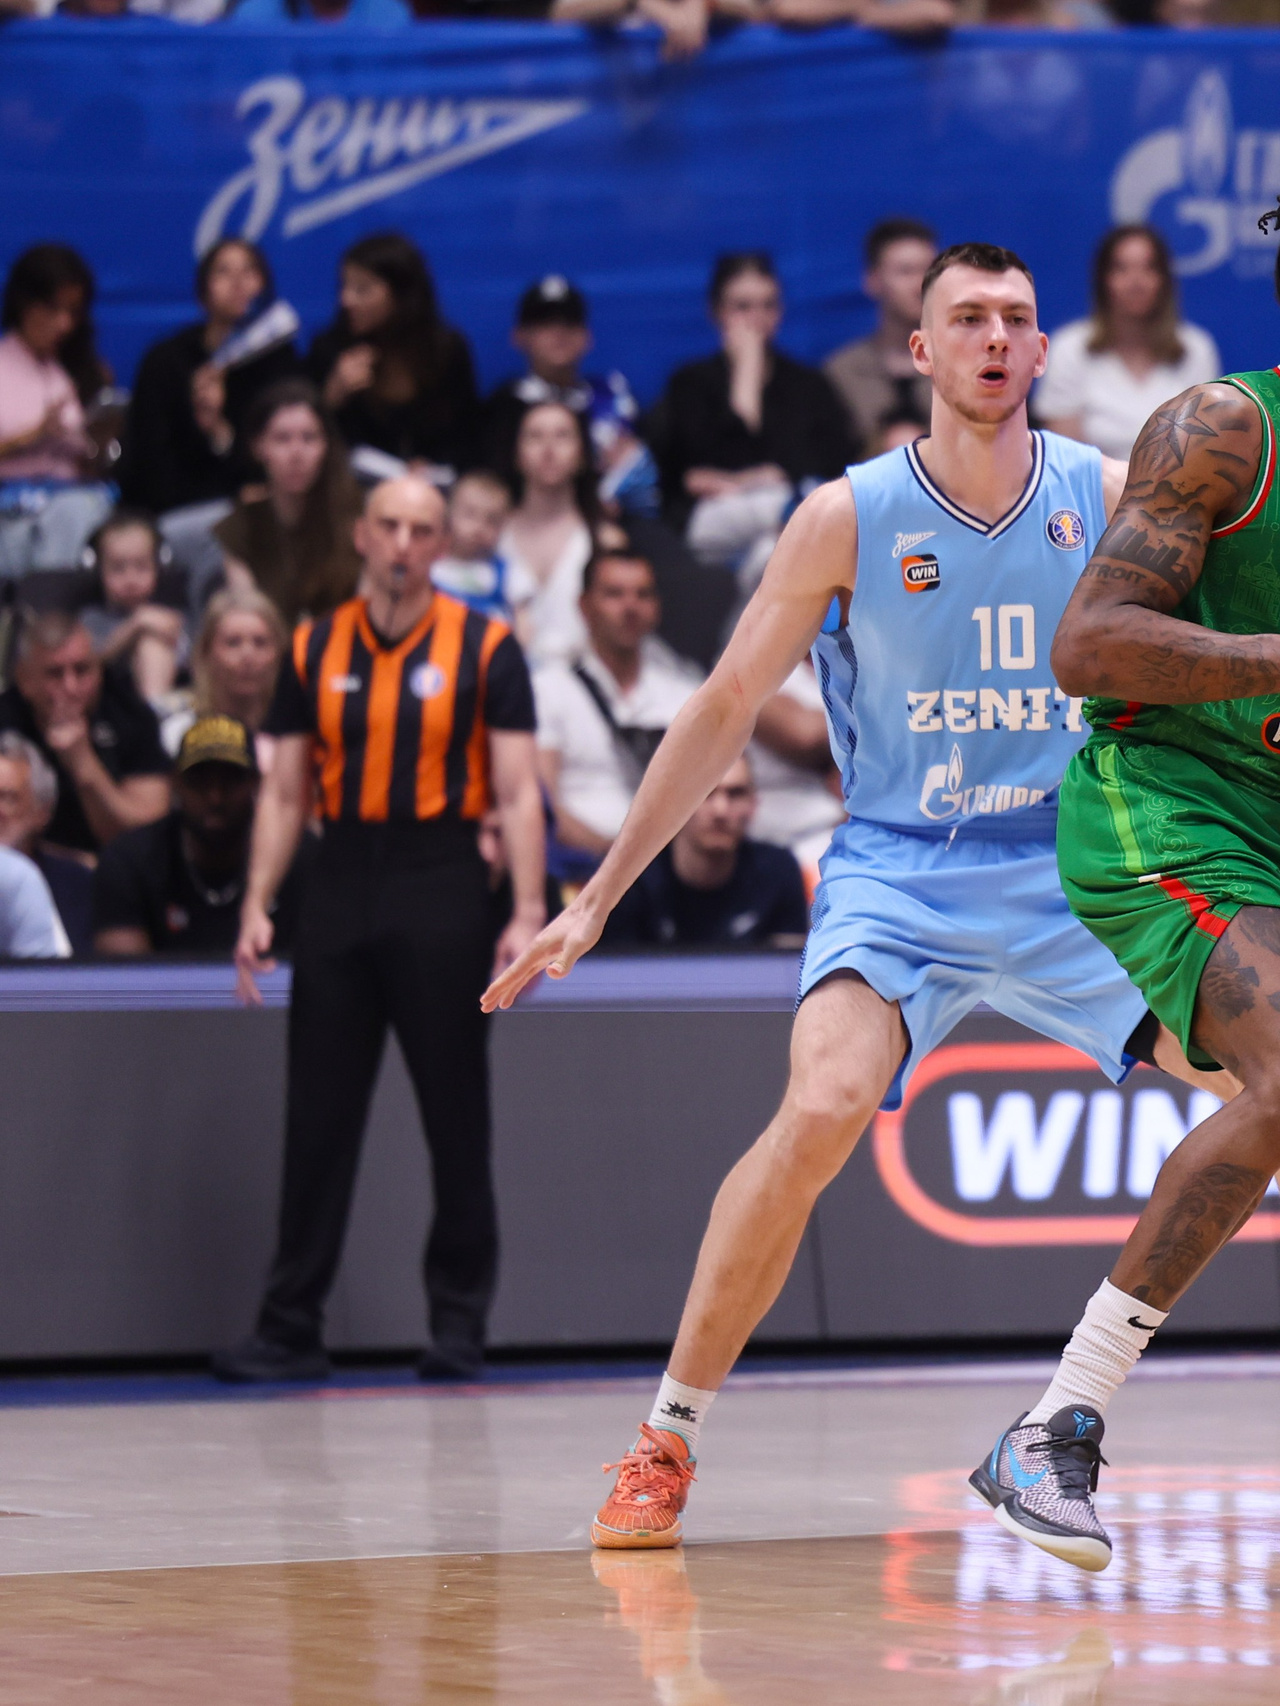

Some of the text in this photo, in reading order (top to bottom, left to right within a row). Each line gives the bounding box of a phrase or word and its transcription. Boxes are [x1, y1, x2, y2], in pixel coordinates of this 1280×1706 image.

[910, 565, 937, 580] WIN
[971, 604, 1036, 671] 10
[907, 687, 1083, 734] ZENIT
[961, 784, 1046, 816] ГАЗПРО
